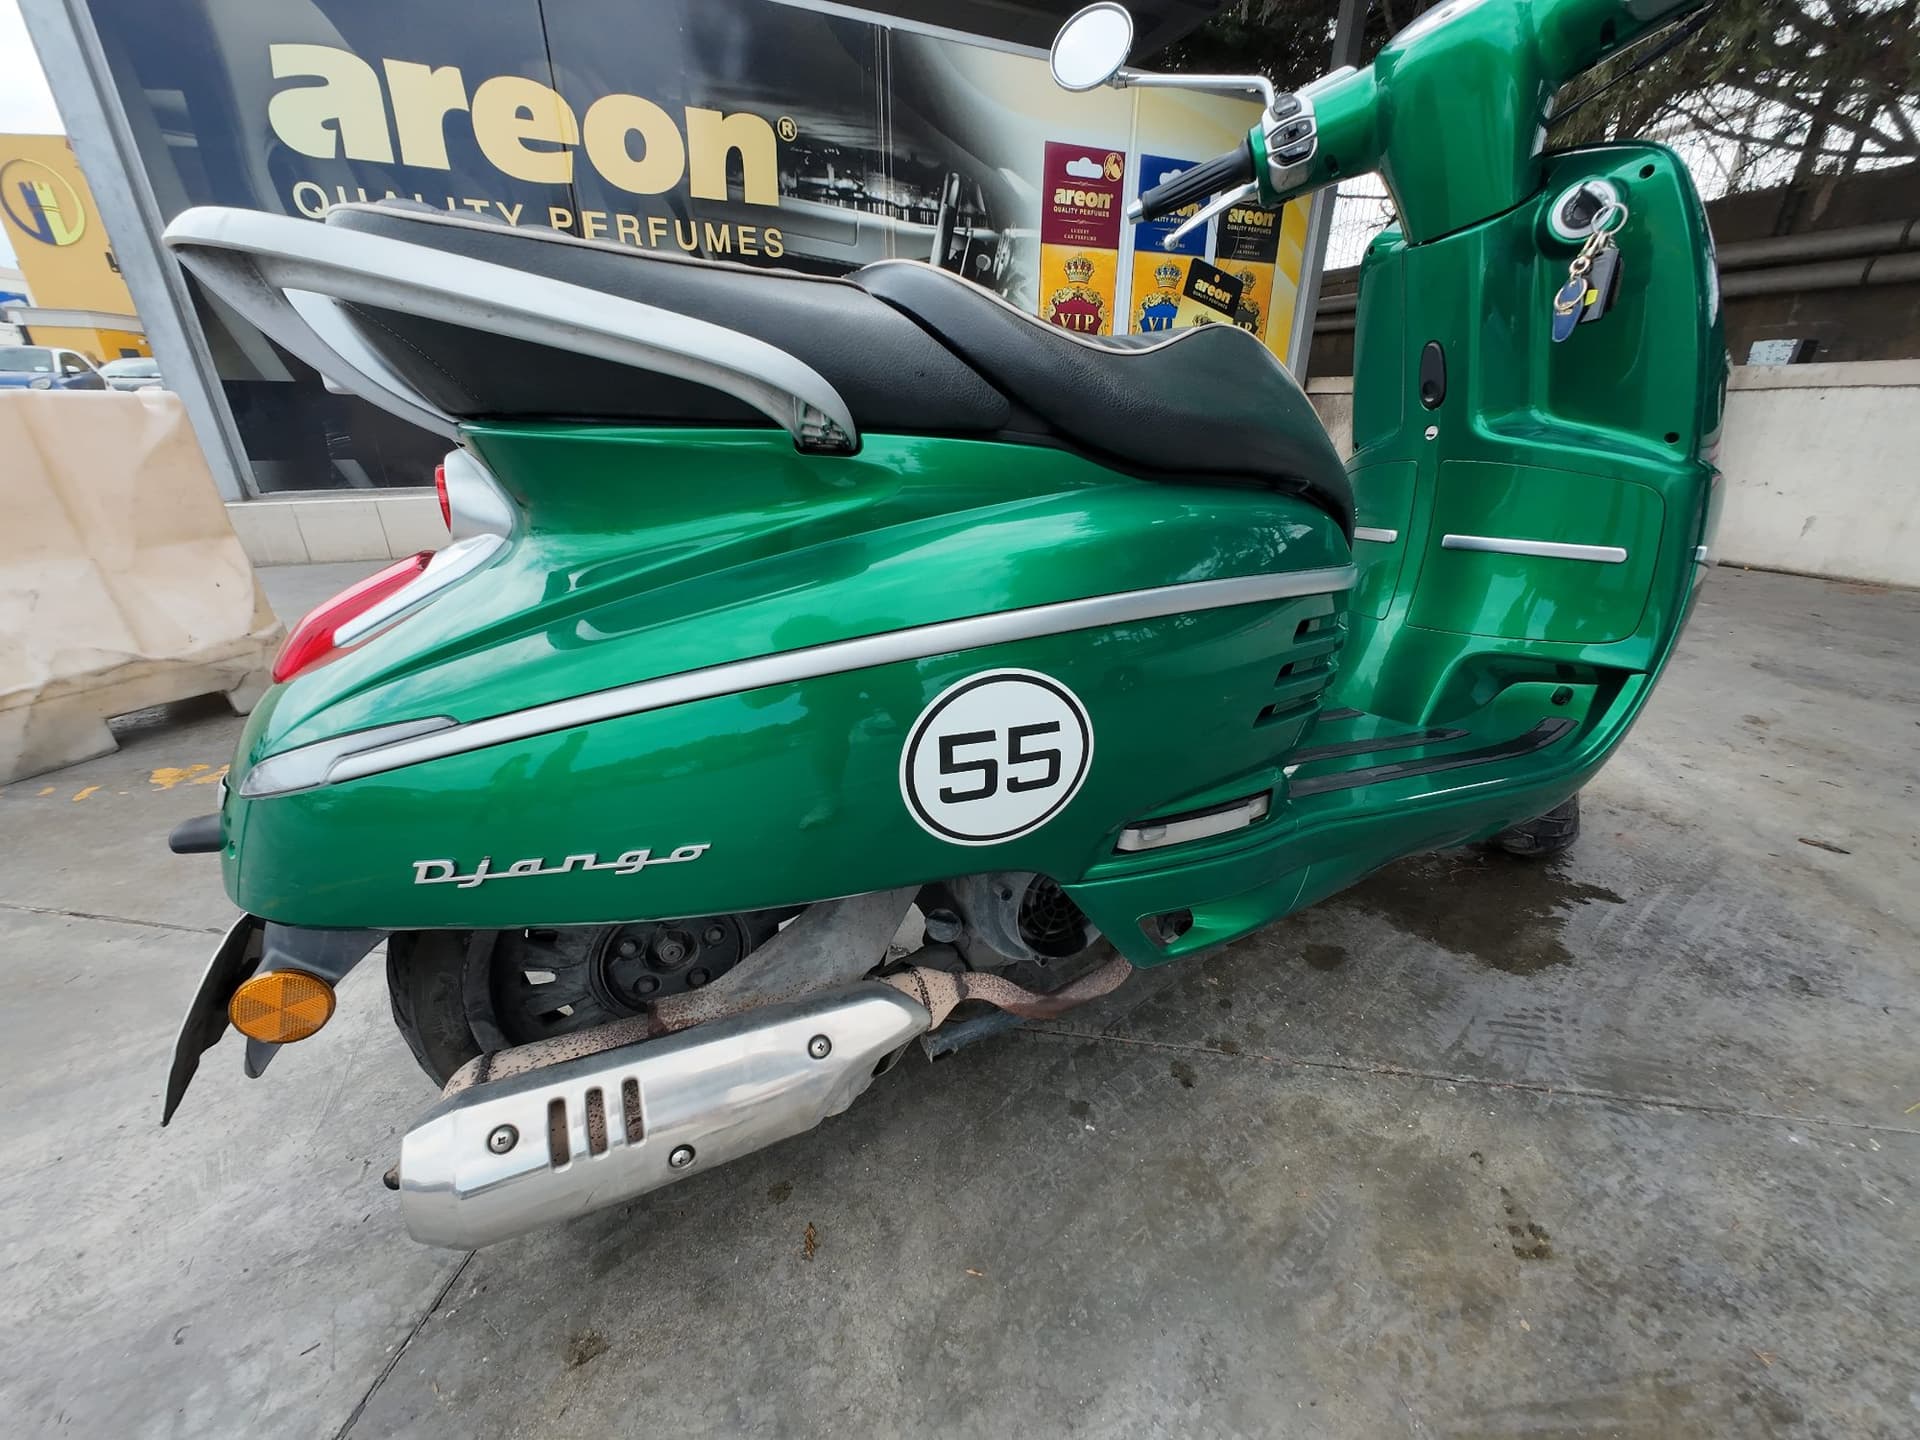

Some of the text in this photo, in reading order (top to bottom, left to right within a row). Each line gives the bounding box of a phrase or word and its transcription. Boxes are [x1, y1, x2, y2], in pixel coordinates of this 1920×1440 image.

[1053, 206, 1110, 218] QUALITY PERFUMES
[549, 206, 785, 258] PERFUMES
[1059, 313, 1095, 331] VIP
[1148, 316, 1175, 332] VI
[939, 720, 1062, 804] 55
[413, 842, 711, 888] Django
